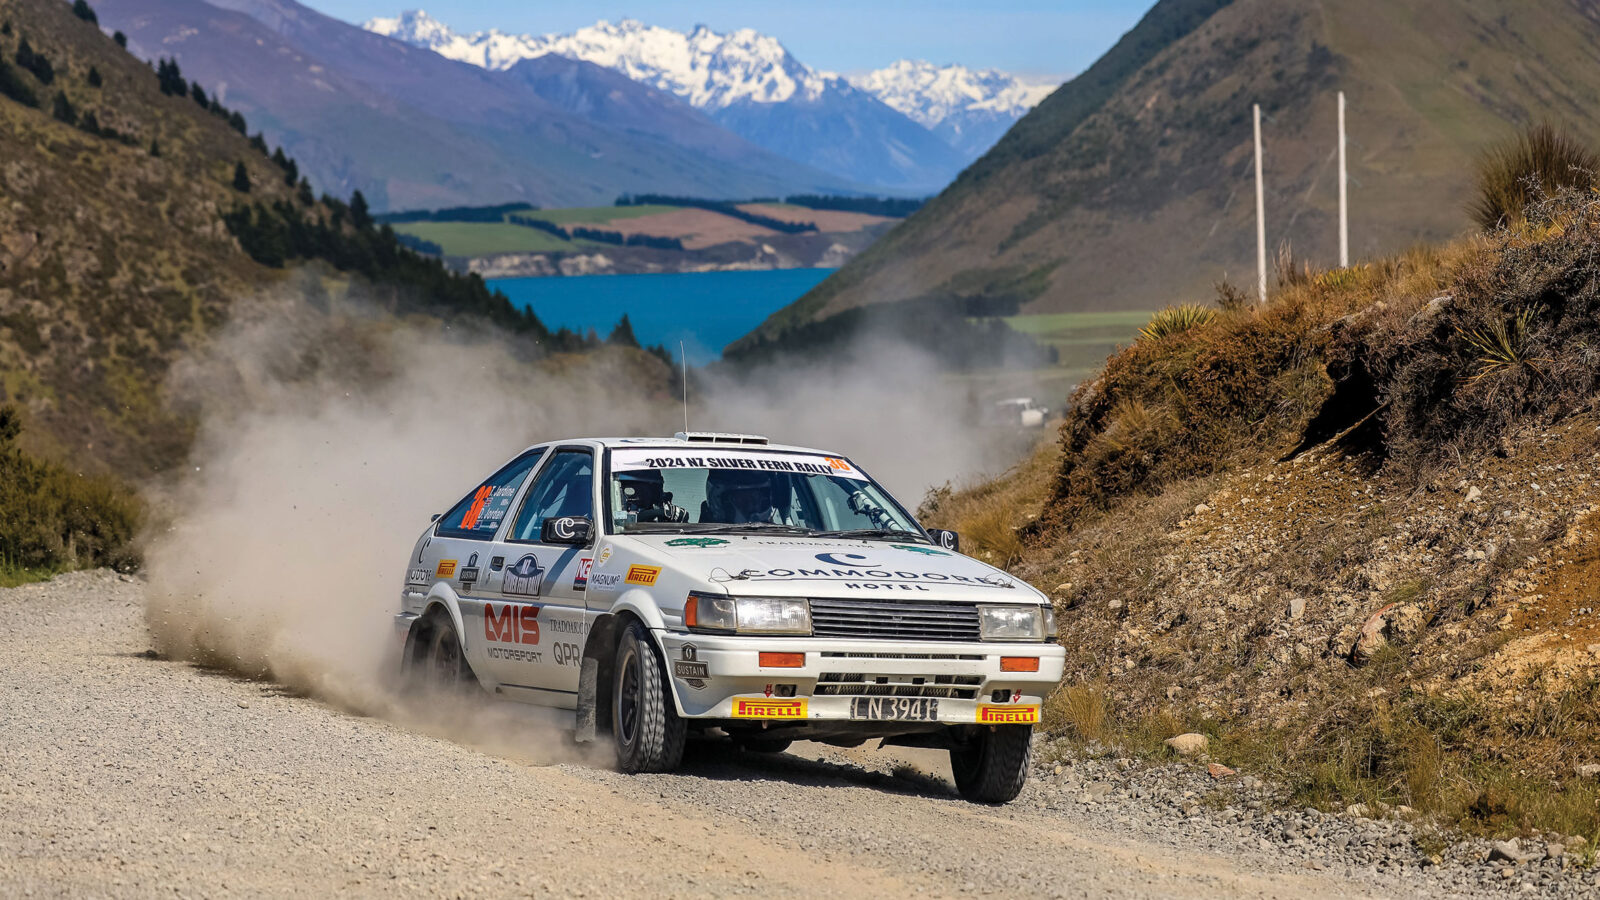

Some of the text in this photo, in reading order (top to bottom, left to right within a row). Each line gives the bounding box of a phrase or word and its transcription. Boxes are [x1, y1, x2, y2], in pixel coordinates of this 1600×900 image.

[645, 457, 834, 475] 2024 NZ SILVER FERN RALLY
[824, 457, 851, 471] 36
[438, 563, 456, 576] PIRELLI
[627, 567, 658, 583] PIRELLI
[844, 582, 930, 592] HOTEL
[484, 603, 540, 646] MIS
[550, 619, 592, 637] TRADOAK.CO
[487, 647, 543, 664] MOTORSPORT
[677, 664, 706, 676] SUSTAIN
[738, 700, 802, 716] PIRELLI
[981, 706, 1035, 722] PIRELLI
